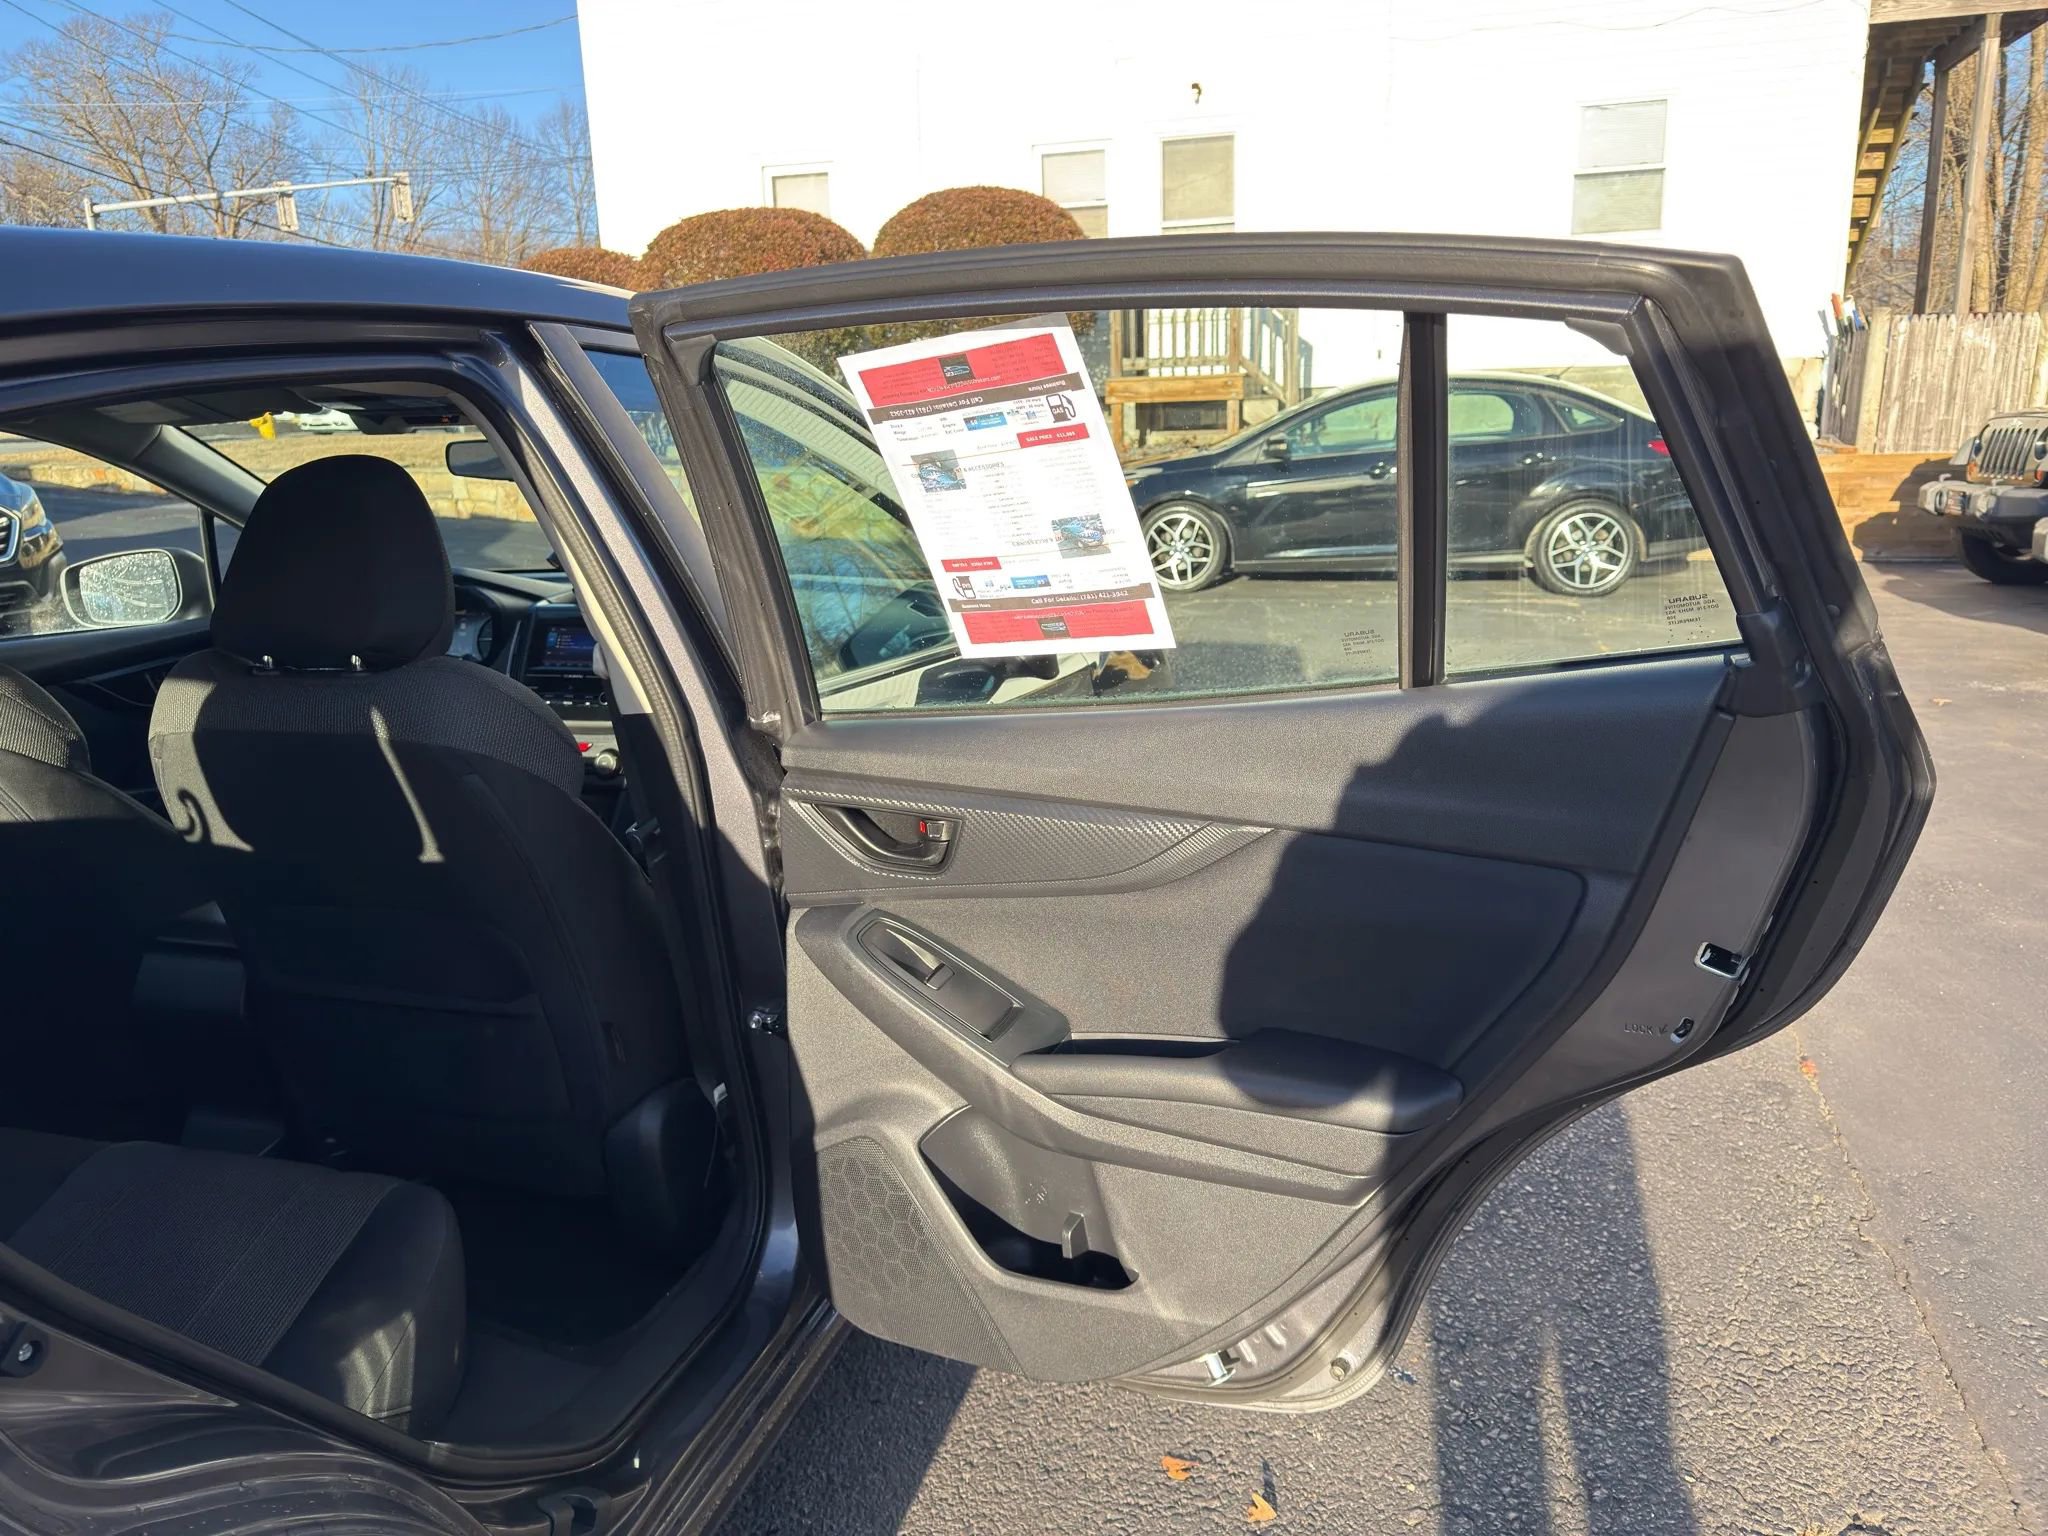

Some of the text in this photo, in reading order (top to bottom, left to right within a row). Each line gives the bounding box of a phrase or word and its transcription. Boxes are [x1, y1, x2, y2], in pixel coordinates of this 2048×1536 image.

[971, 396, 984, 404] Call
[933, 401, 958, 409] Details:
[1624, 1023, 1653, 1036] LOCK
